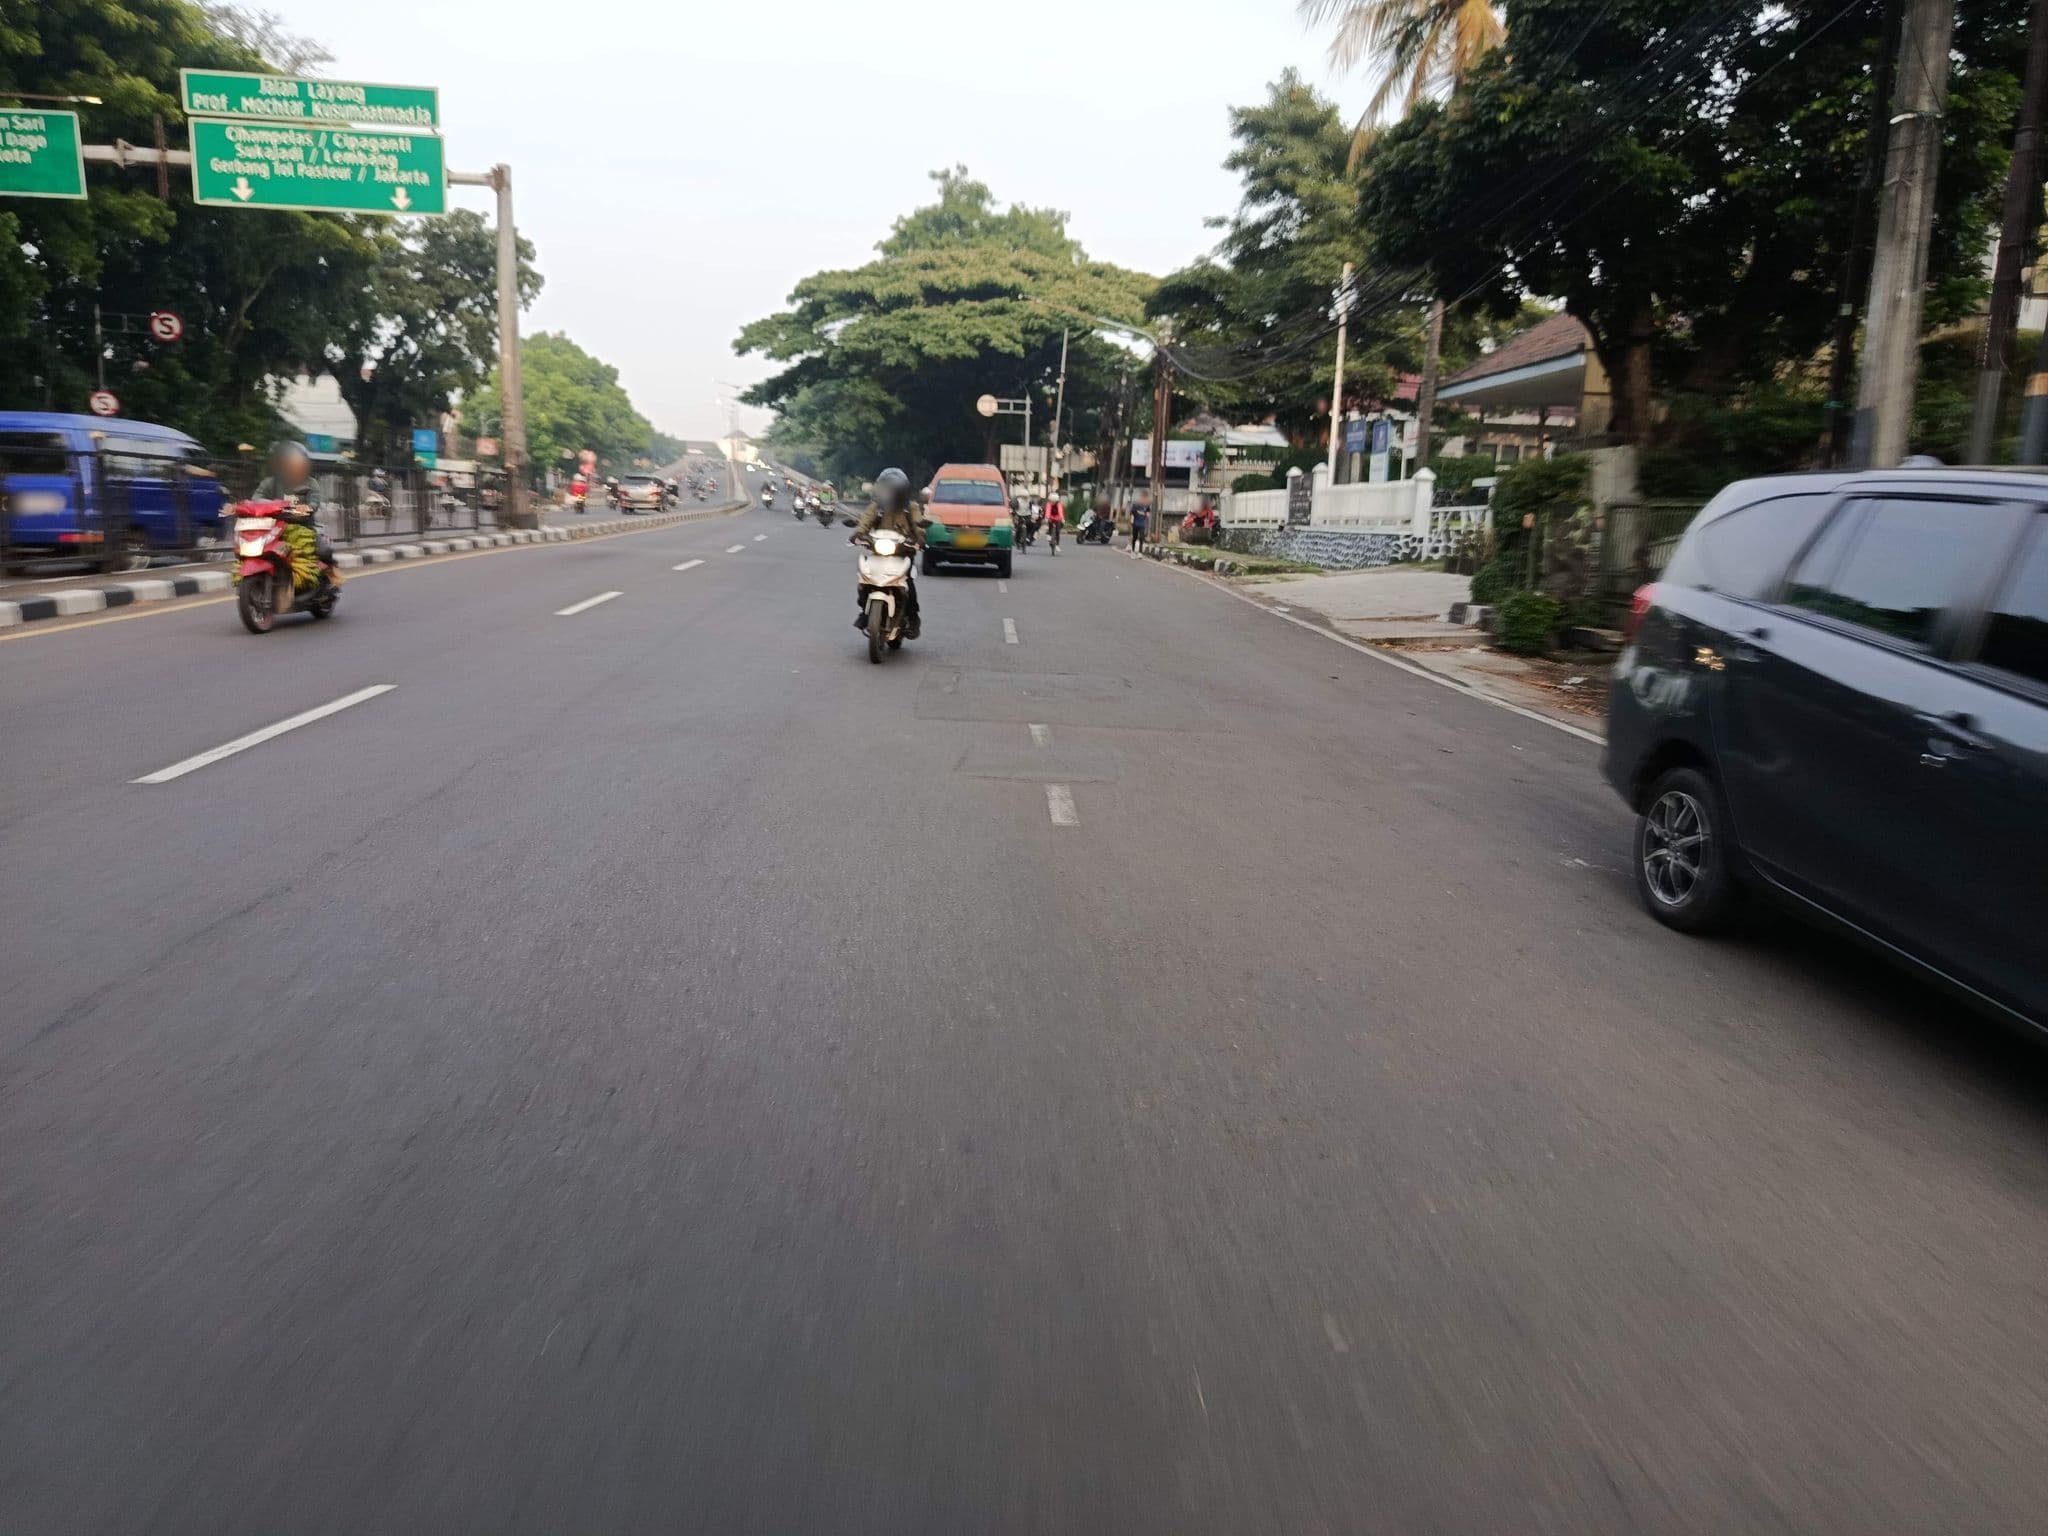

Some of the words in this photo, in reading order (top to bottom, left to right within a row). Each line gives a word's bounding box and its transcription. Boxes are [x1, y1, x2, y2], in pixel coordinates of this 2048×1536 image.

[259, 80, 299, 97] Jalan
[308, 83, 365, 104] Layang
[241, 96, 306, 116] Mochtar
[11, 115, 46, 132] Sari
[6, 132, 47, 152] Dago
[225, 126, 314, 146] Cihampelas
[318, 132, 328, 149] /
[332, 133, 412, 154] Cipaganti
[235, 143, 304, 162] Sukajadi
[309, 148, 319, 165] /
[323, 148, 398, 170] Lembang
[210, 157, 270, 179] Gerbang
[272, 160, 295, 177] Tol
[297, 163, 353, 181] Pasteur
[357, 166, 368, 184] /
[374, 167, 430, 186] Jakarta
